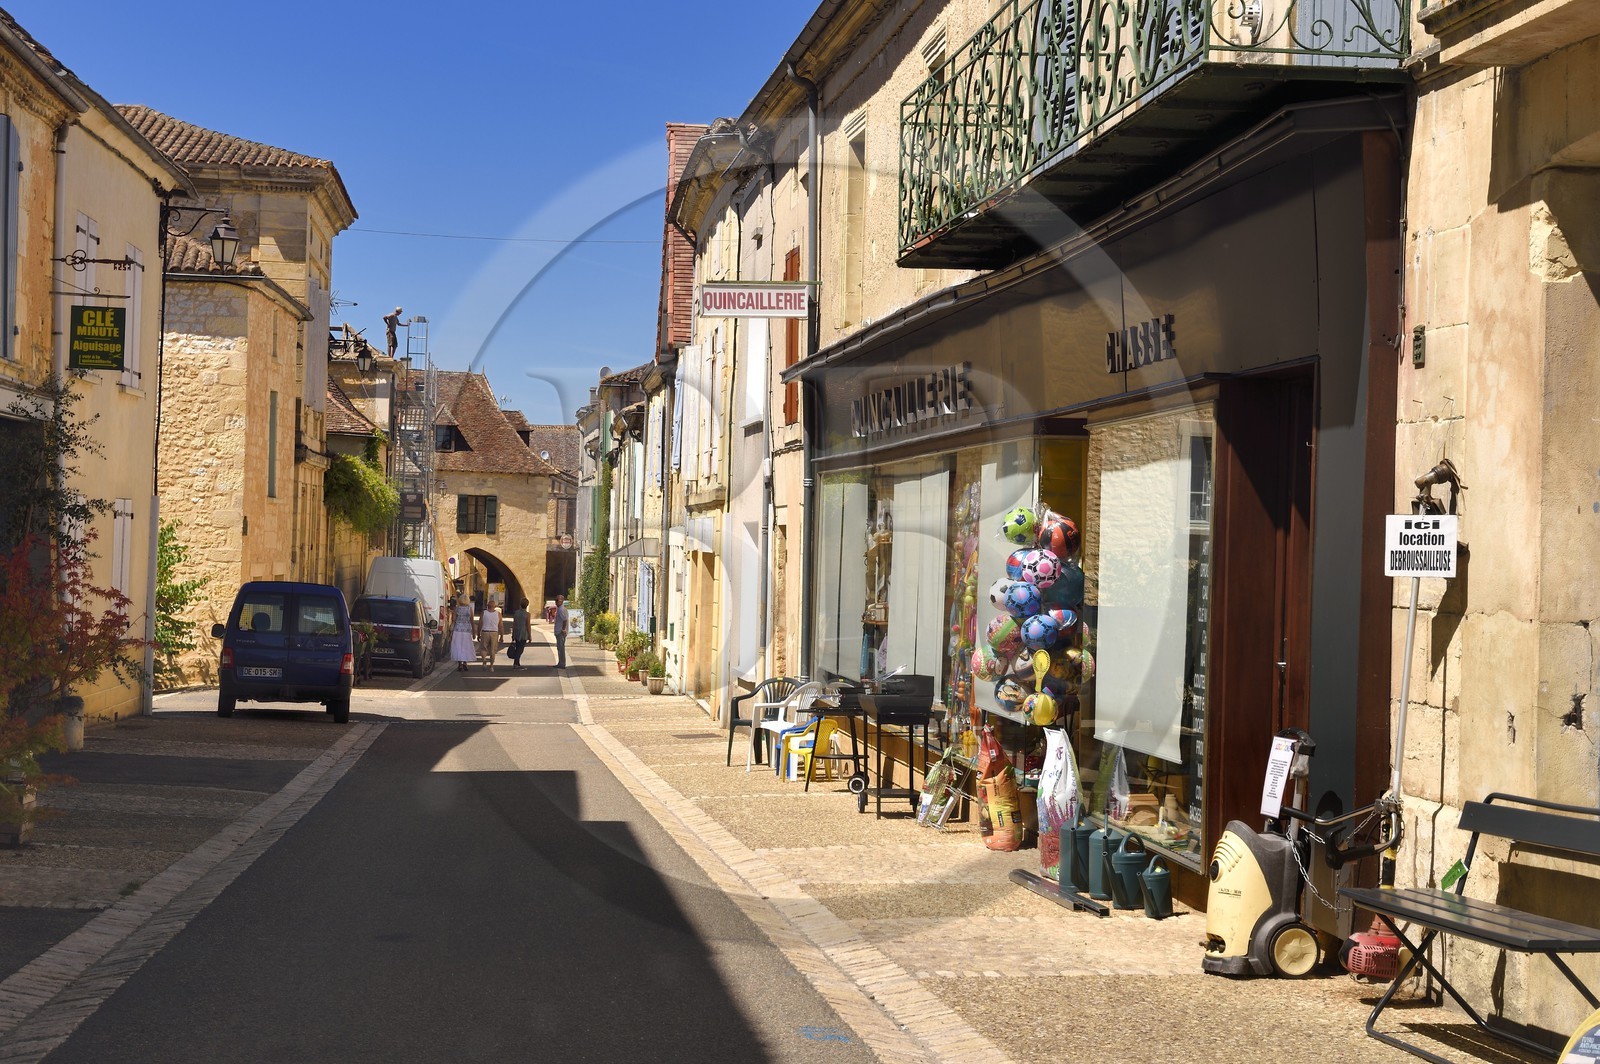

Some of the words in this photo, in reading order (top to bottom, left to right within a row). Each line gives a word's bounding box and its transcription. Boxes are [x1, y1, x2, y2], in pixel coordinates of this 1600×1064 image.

[703, 292, 806, 311] QUINCAILLERIE
[83, 308, 114, 327] CLÉ
[77, 326, 119, 337] MINUTE
[73, 340, 122, 352] Aiguisage
[1105, 314, 1173, 374] CHASSE
[851, 361, 972, 438] QUINCAILLERIE
[1399, 531, 1445, 546] location
[1390, 550, 1451, 571] DEBROUSSAILLEUSE
